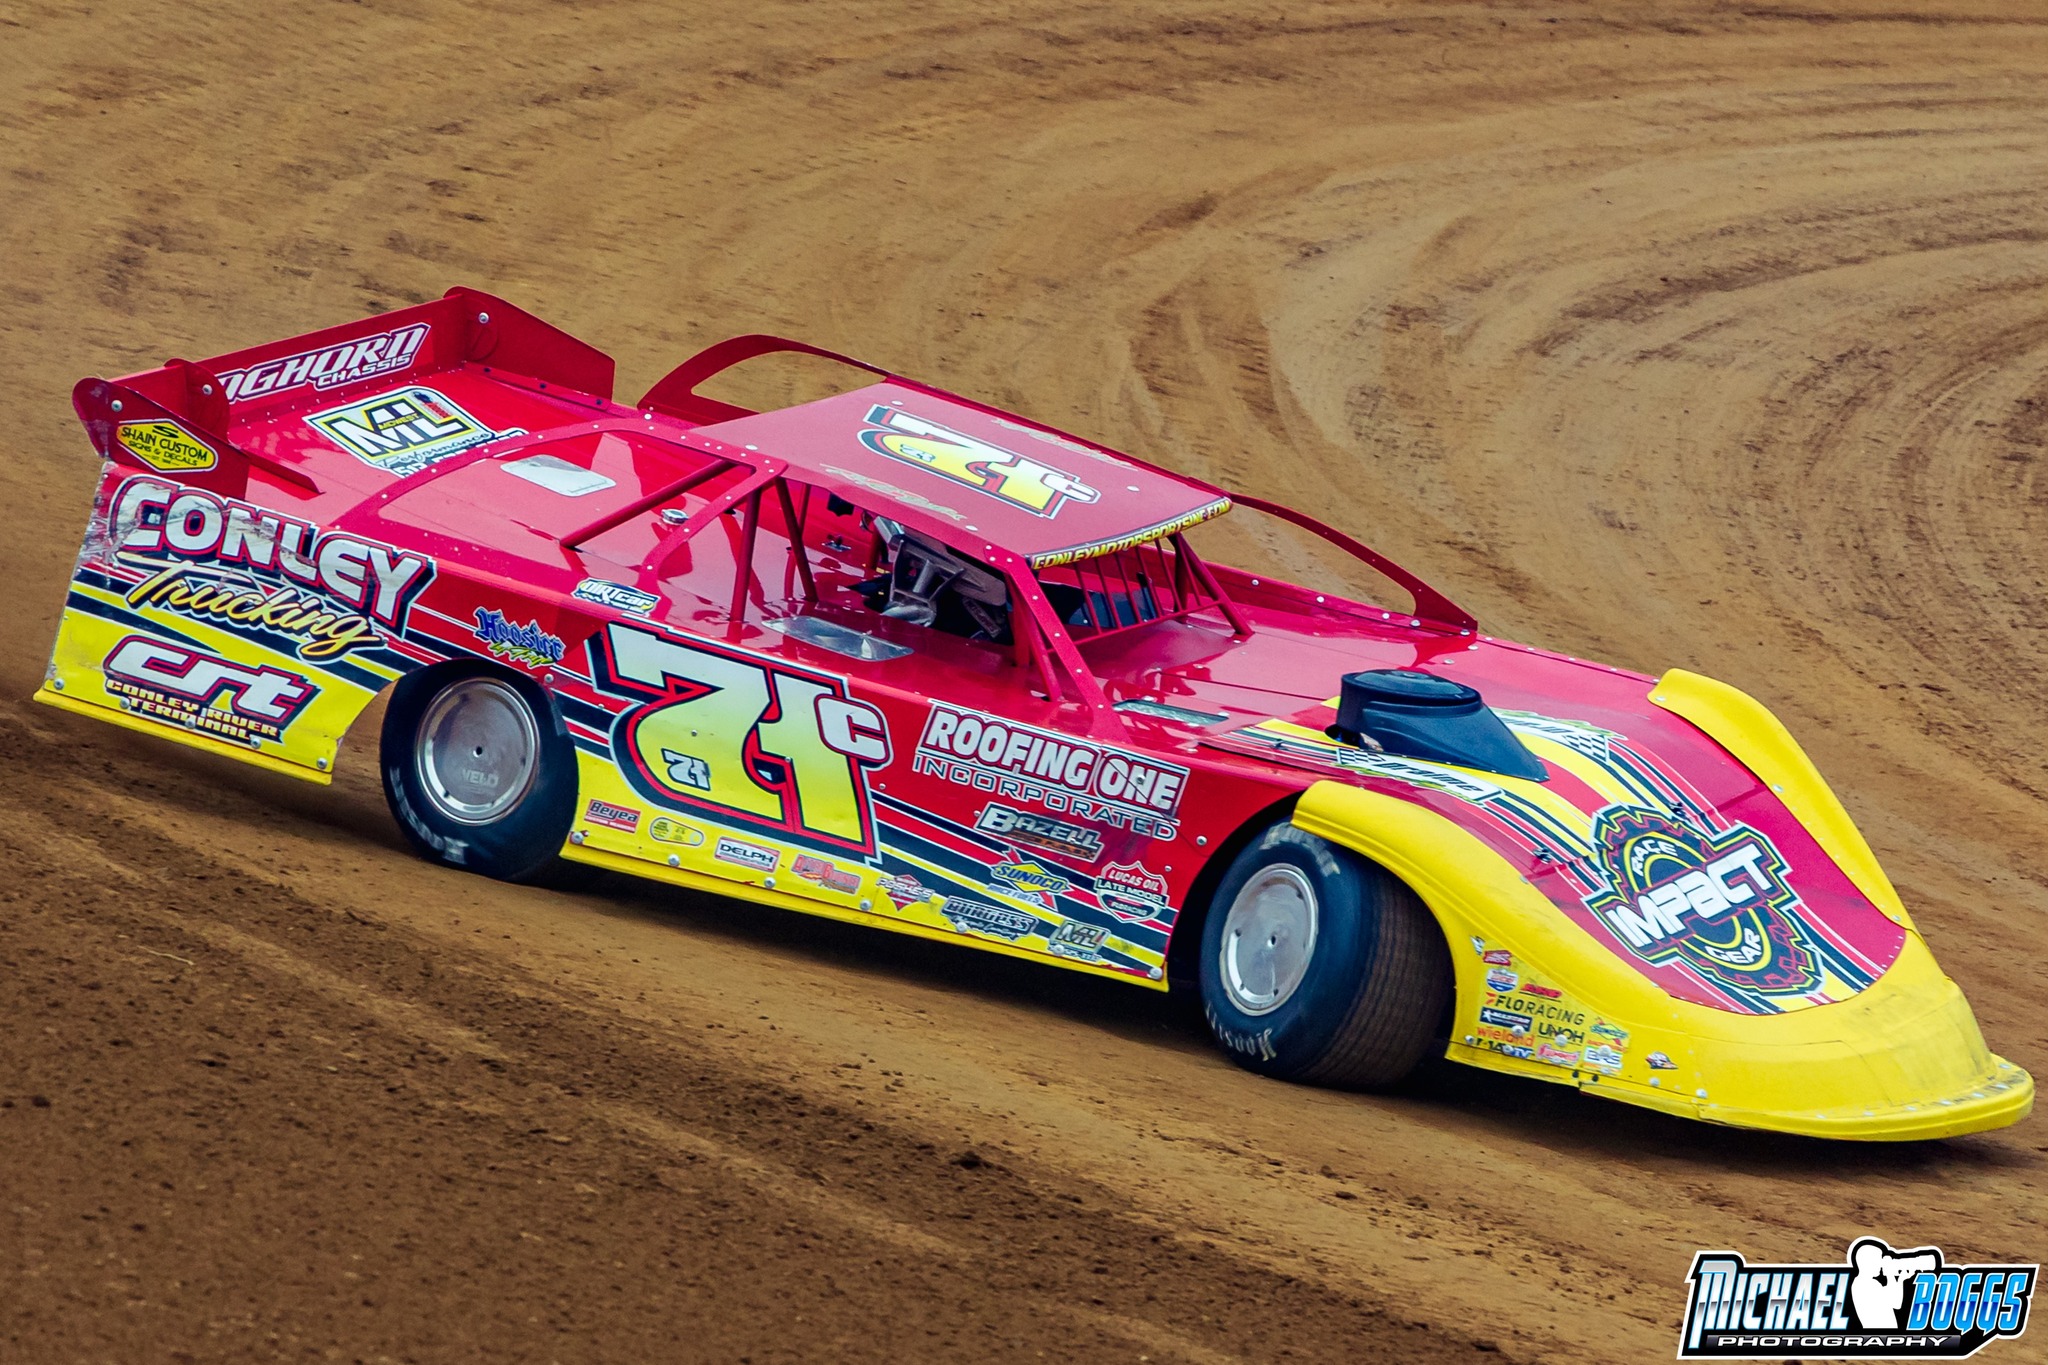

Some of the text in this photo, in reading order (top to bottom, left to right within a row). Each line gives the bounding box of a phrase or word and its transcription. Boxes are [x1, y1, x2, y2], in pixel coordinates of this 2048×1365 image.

[316, 353, 411, 386] CHASSIS
[377, 412, 419, 430] MIDWEST
[121, 426, 157, 446] SHAIN
[159, 438, 208, 462] CUSTOM
[128, 440, 152, 453] SIGNS
[163, 451, 198, 466] DECALS
[112, 478, 428, 625] CONLEY
[116, 551, 381, 657] Trucking
[475, 607, 566, 661] Hoosier
[106, 679, 279, 737] CONLEY RIVER
[128, 696, 251, 740] TERMINAL
[926, 710, 1181, 811] ROOFING ONE
[589, 801, 639, 822] Beyea
[914, 755, 1178, 841] INCORPORATED
[981, 807, 1098, 850] BAZELL
[720, 844, 774, 863] DELPH
[1632, 839, 1679, 877] RACE
[996, 865, 1064, 891] SUNOCO
[1098, 878, 1163, 905] LATE MODEL
[1108, 869, 1160, 892] LUCAS OIL
[1604, 843, 1773, 948] IMPACT
[1704, 927, 1762, 964] GEAR
[1538, 1022, 1585, 1045] UNOH
